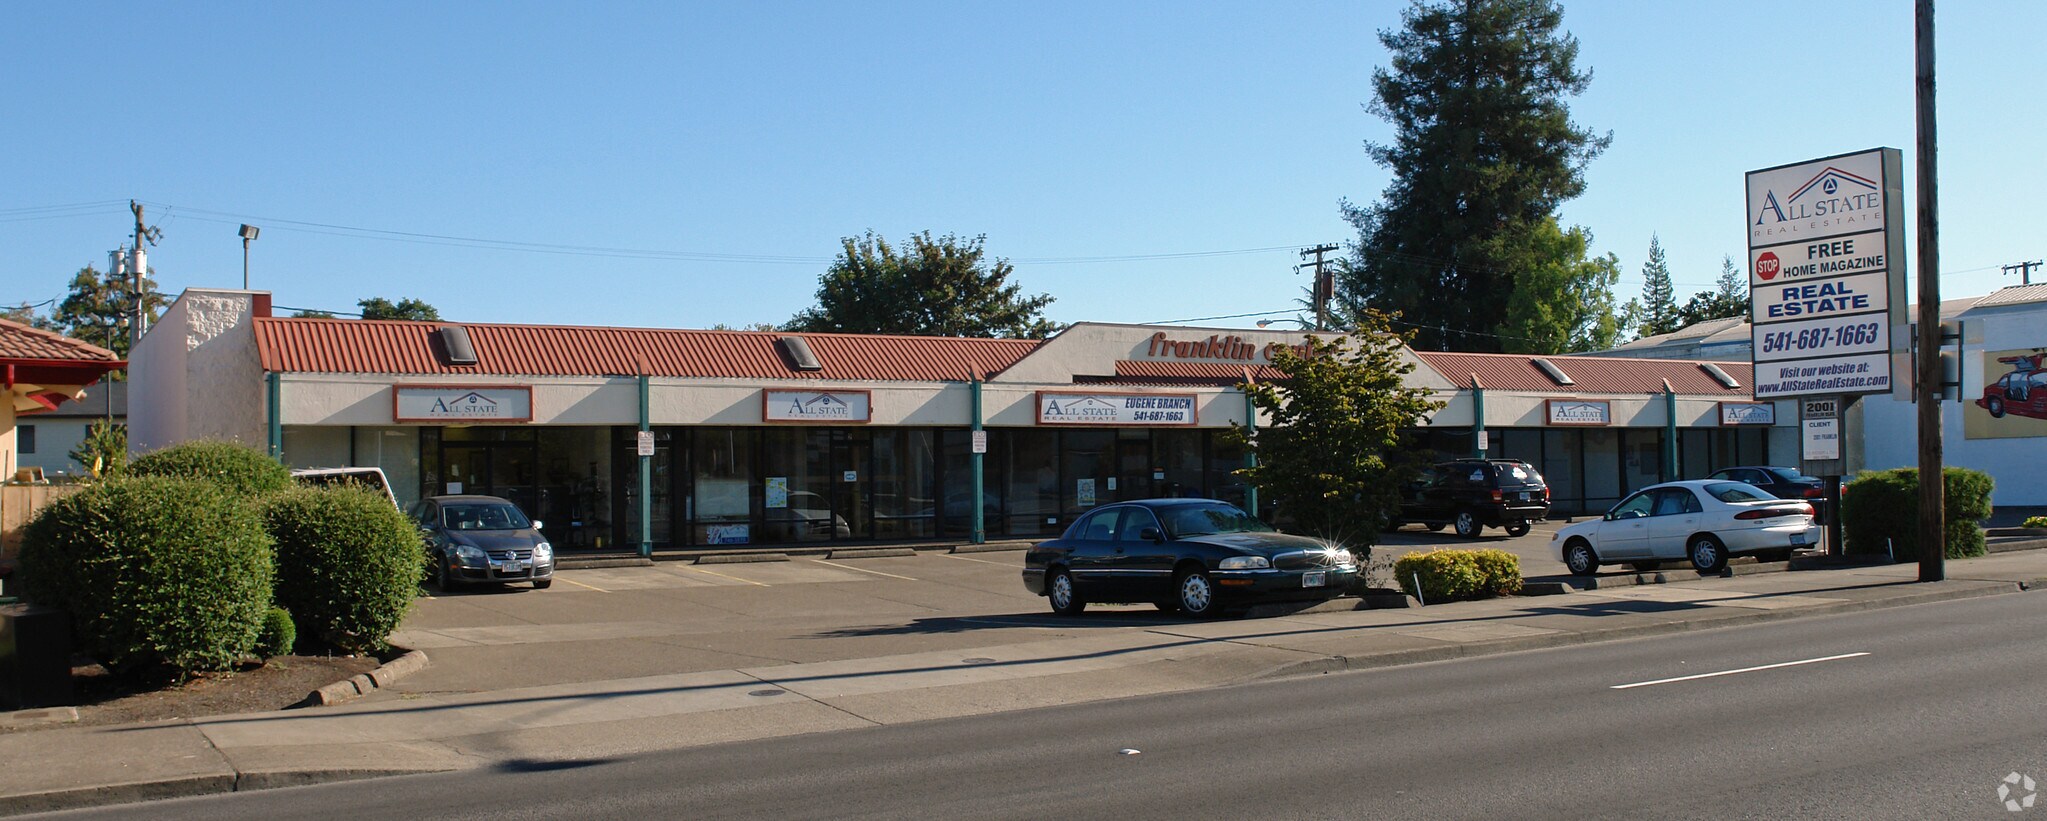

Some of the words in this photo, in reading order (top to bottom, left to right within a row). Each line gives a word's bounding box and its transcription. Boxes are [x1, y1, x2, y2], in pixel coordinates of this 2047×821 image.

[1755, 189, 1812, 226] ALL
[1815, 192, 1880, 217] STATE
[1754, 225, 1798, 237] REAL
[1810, 212, 1881, 229] ESTATE
[1807, 240, 1854, 260] FREE
[1757, 260, 1778, 274] STOP
[1783, 264, 1817, 278] HOME
[1820, 255, 1884, 273] MAGAZINE
[1782, 281, 1853, 301] REAL
[1768, 294, 1870, 318] ESTATE
[1148, 331, 1256, 360] franklin
[1763, 322, 1879, 353] 541-687-1663
[1780, 366, 1801, 379] Visit
[1801, 367, 1817, 377] our
[1818, 363, 1856, 376] website
[1857, 362, 1870, 373] at:
[1757, 375, 1888, 394] www.AllStateRealEstate.com
[431, 397, 461, 412] ALL
[464, 405, 497, 413] STATE
[789, 397, 816, 414] ALL
[818, 407, 848, 415] STATE
[1044, 399, 1079, 415] ALL
[1082, 407, 1118, 416] STATE
[1124, 398, 1156, 409] EUGENE
[1157, 398, 1191, 410] BRANCH
[1556, 405, 1578, 417] ALL
[1806, 402, 1834, 412] 2001
[1133, 410, 1184, 421] 541-687-1663
